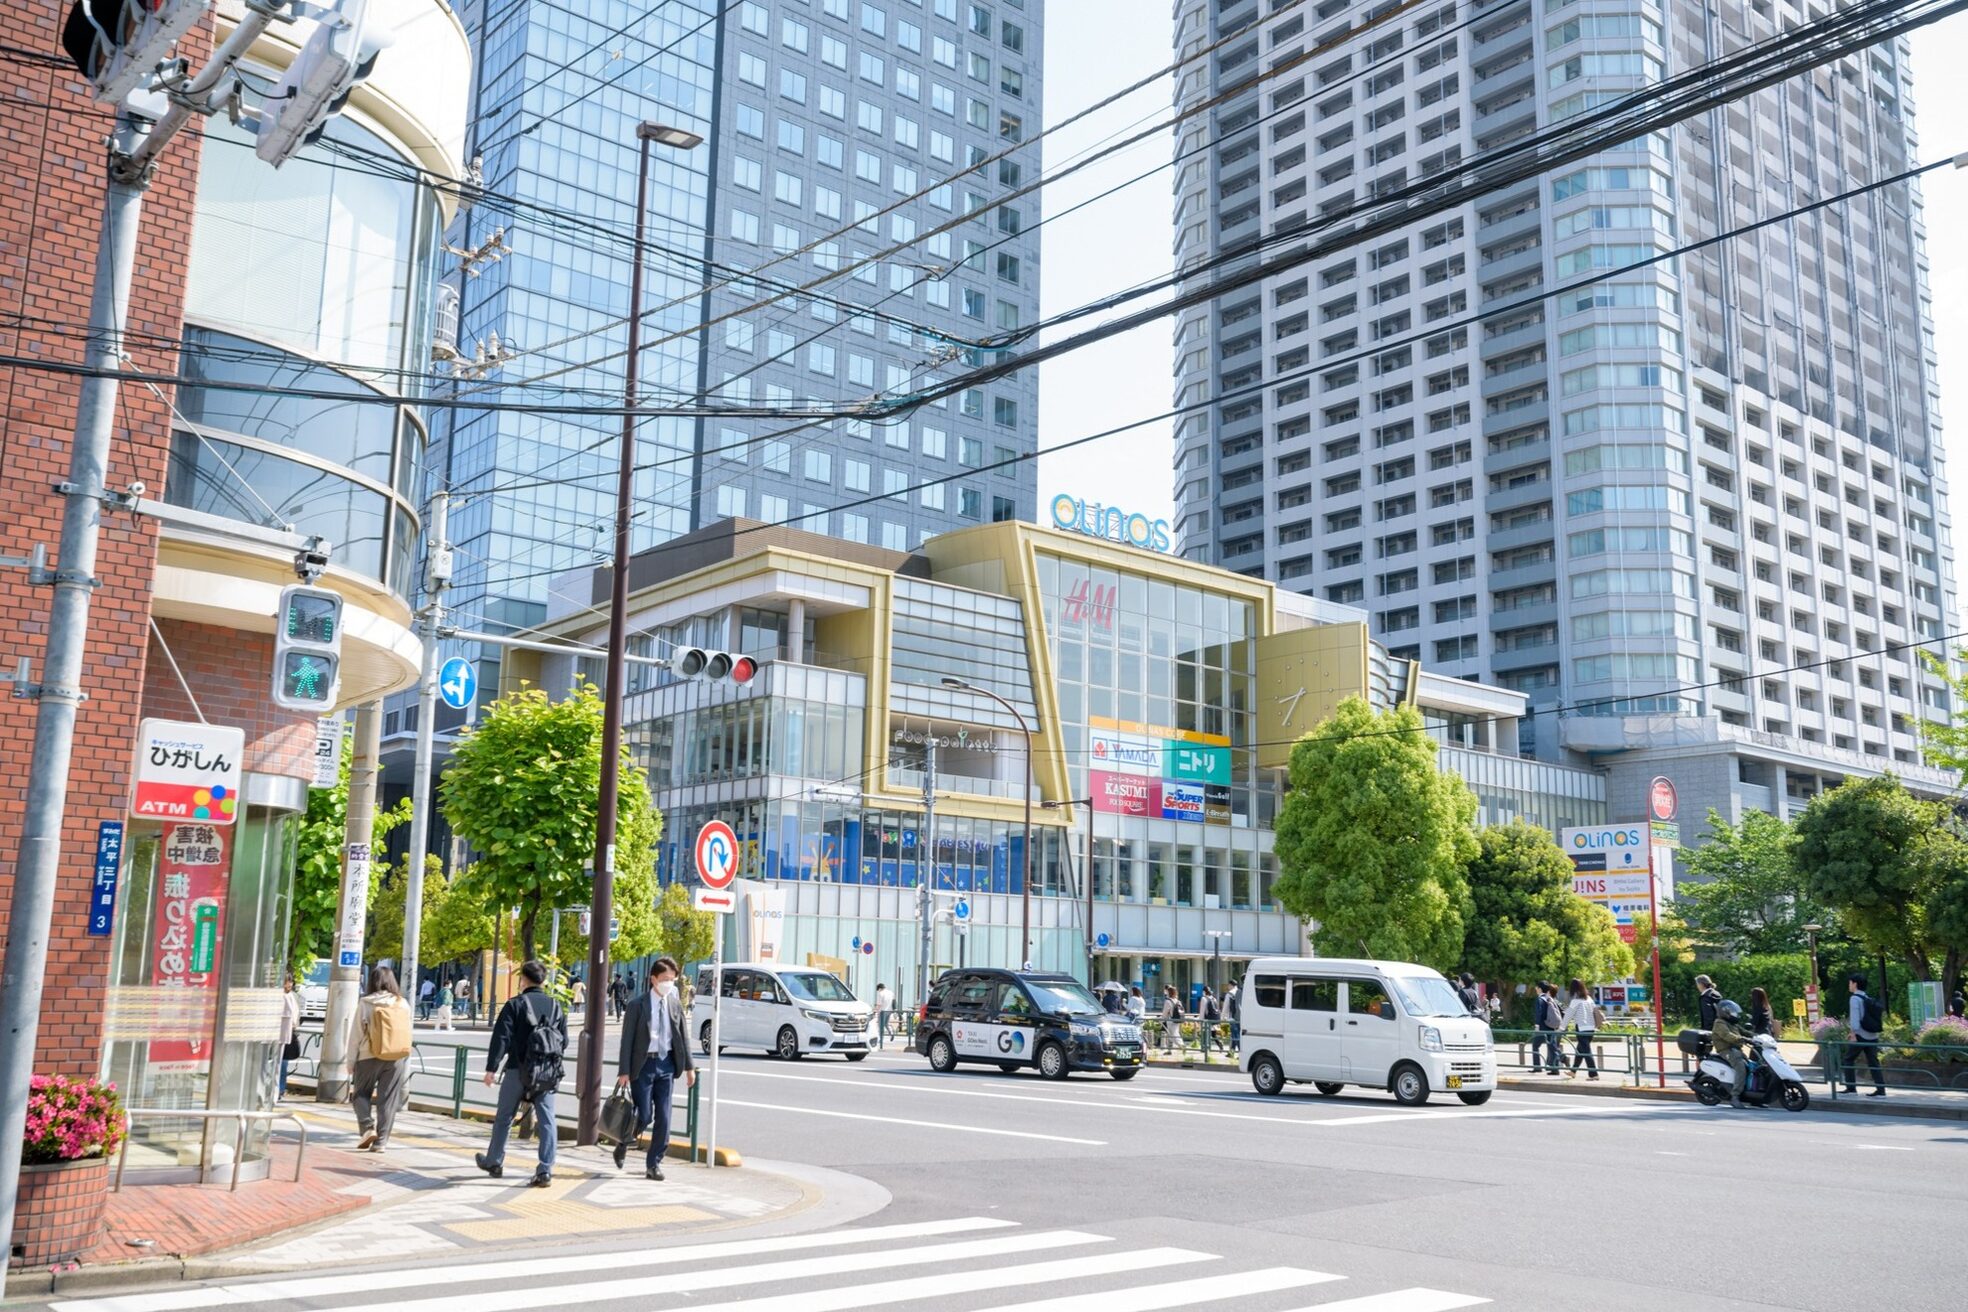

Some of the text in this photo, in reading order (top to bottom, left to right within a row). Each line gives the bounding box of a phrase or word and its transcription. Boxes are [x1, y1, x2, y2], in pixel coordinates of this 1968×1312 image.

[152, 739, 204, 750] キャッシュサービス
[1112, 743, 1157, 764] YAMADA
[150, 747, 231, 772] ひがしん
[1180, 750, 1215, 774] ニトリ
[1105, 782, 1147, 799] KASUMI
[1174, 789, 1203, 803] SUPER
[141, 801, 187, 815] ATM
[1164, 796, 1200, 811] SPORTS
[96, 838, 119, 928] 太平三丁目 3
[997, 1030, 1025, 1054] GO
